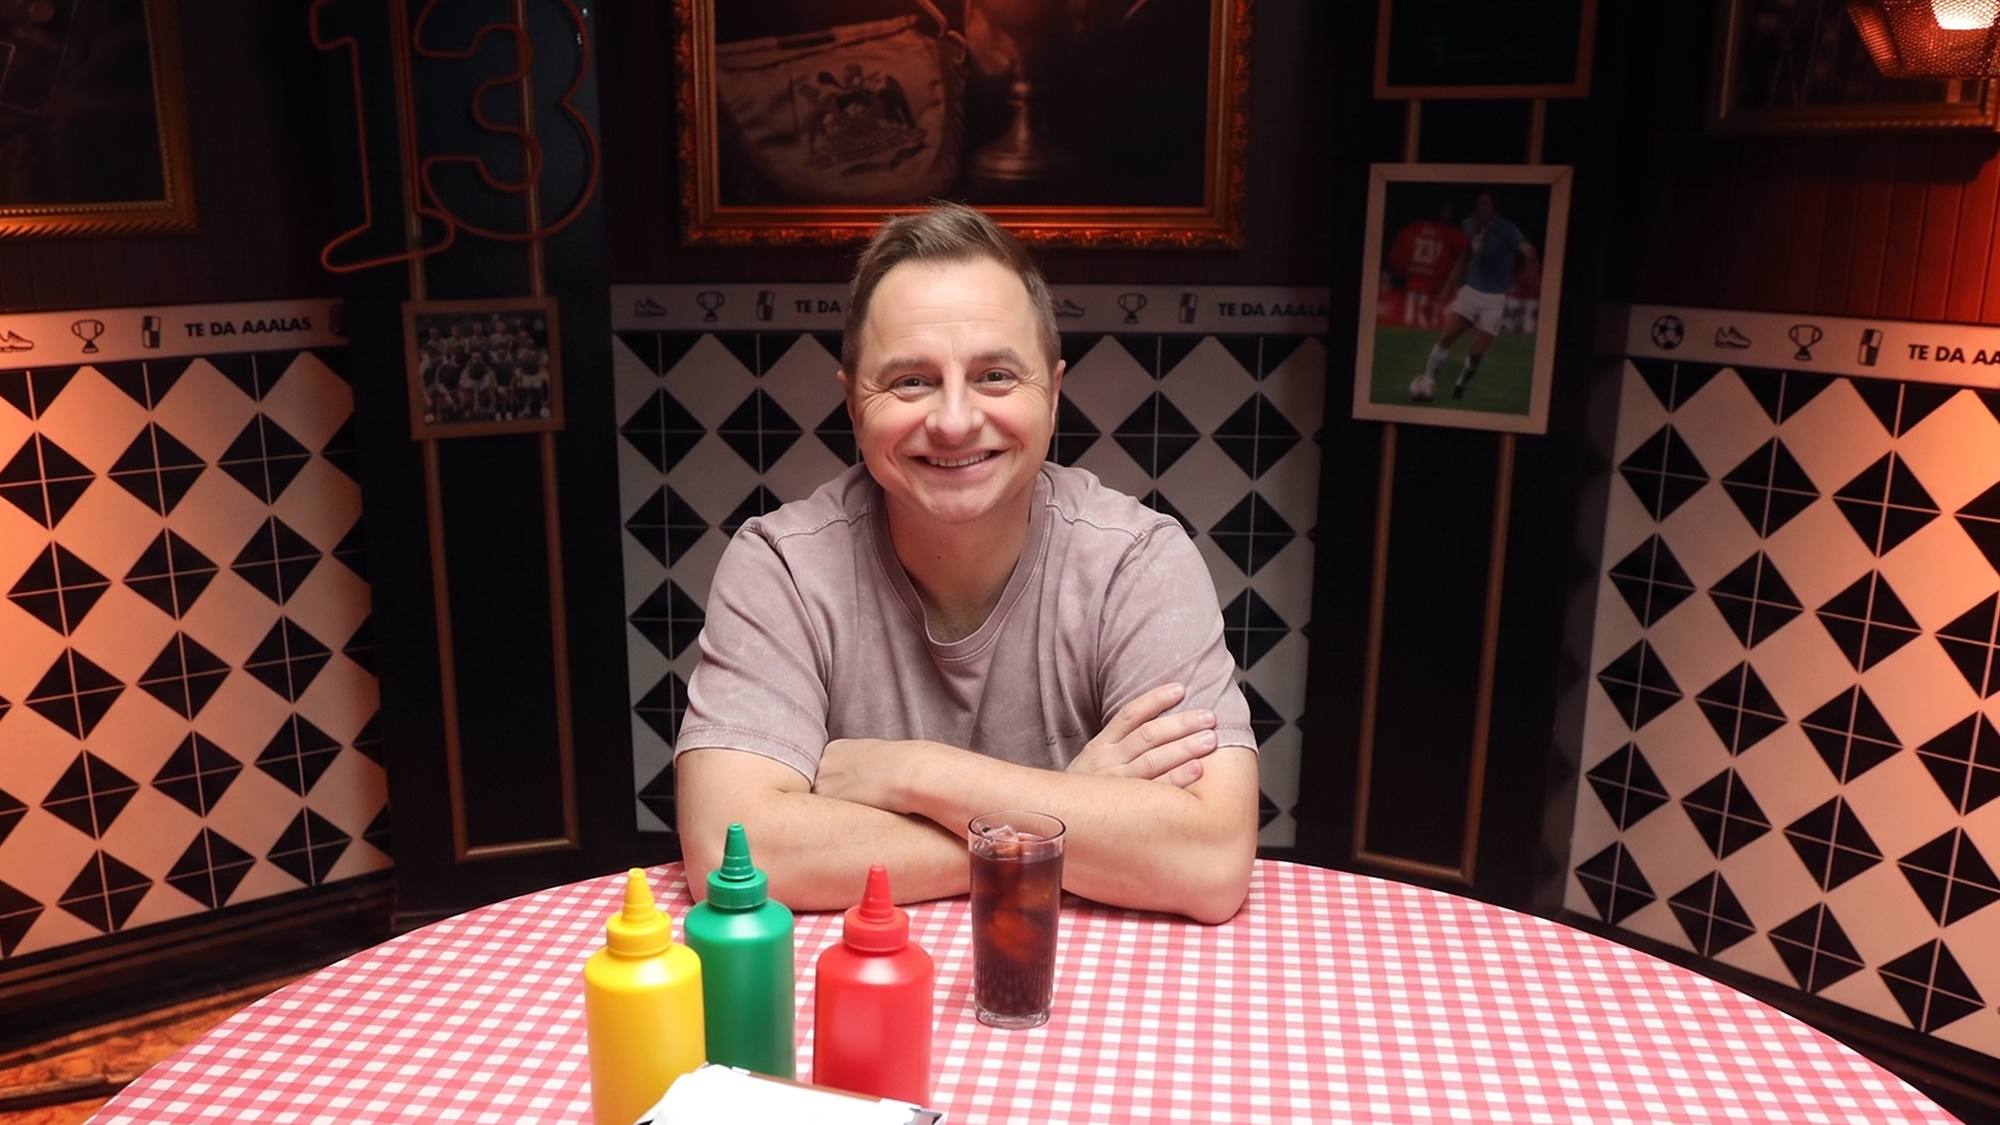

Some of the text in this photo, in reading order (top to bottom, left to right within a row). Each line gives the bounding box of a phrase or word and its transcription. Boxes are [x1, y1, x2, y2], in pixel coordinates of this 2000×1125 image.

[309, 0, 600, 272] 13
[795, 300, 841, 313] TE DA
[1217, 303, 1236, 316] TE
[1241, 303, 1265, 316] DA
[185, 316, 312, 338] TE DA AAALAS
[1908, 344, 1929, 360] TE
[1935, 346, 1965, 363] DA
